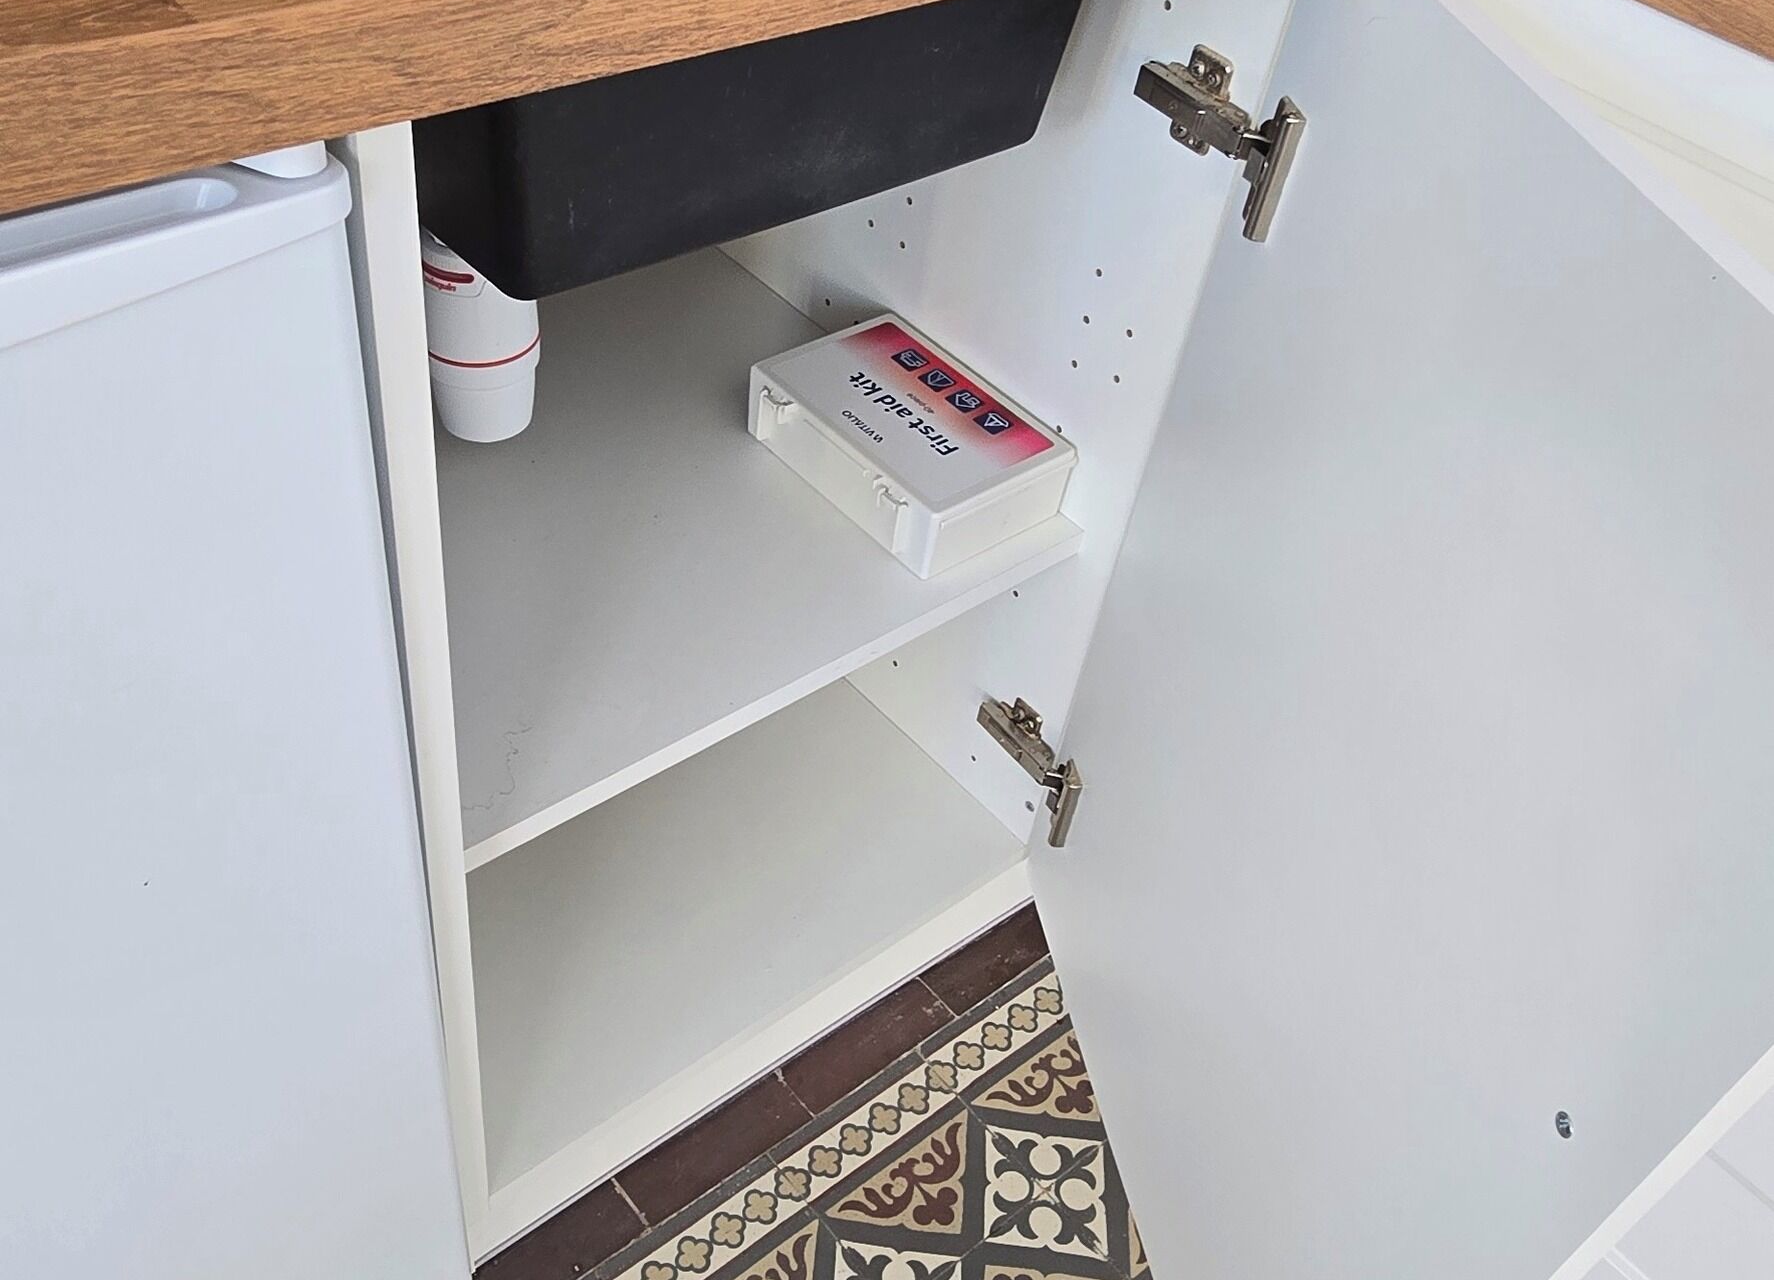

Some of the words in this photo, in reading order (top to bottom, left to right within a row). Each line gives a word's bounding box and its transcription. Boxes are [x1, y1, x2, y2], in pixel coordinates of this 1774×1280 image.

[849, 371, 883, 396] kit
[872, 394, 913, 418] aid
[841, 410, 876, 437] VITALIO
[908, 418, 959, 456] First
